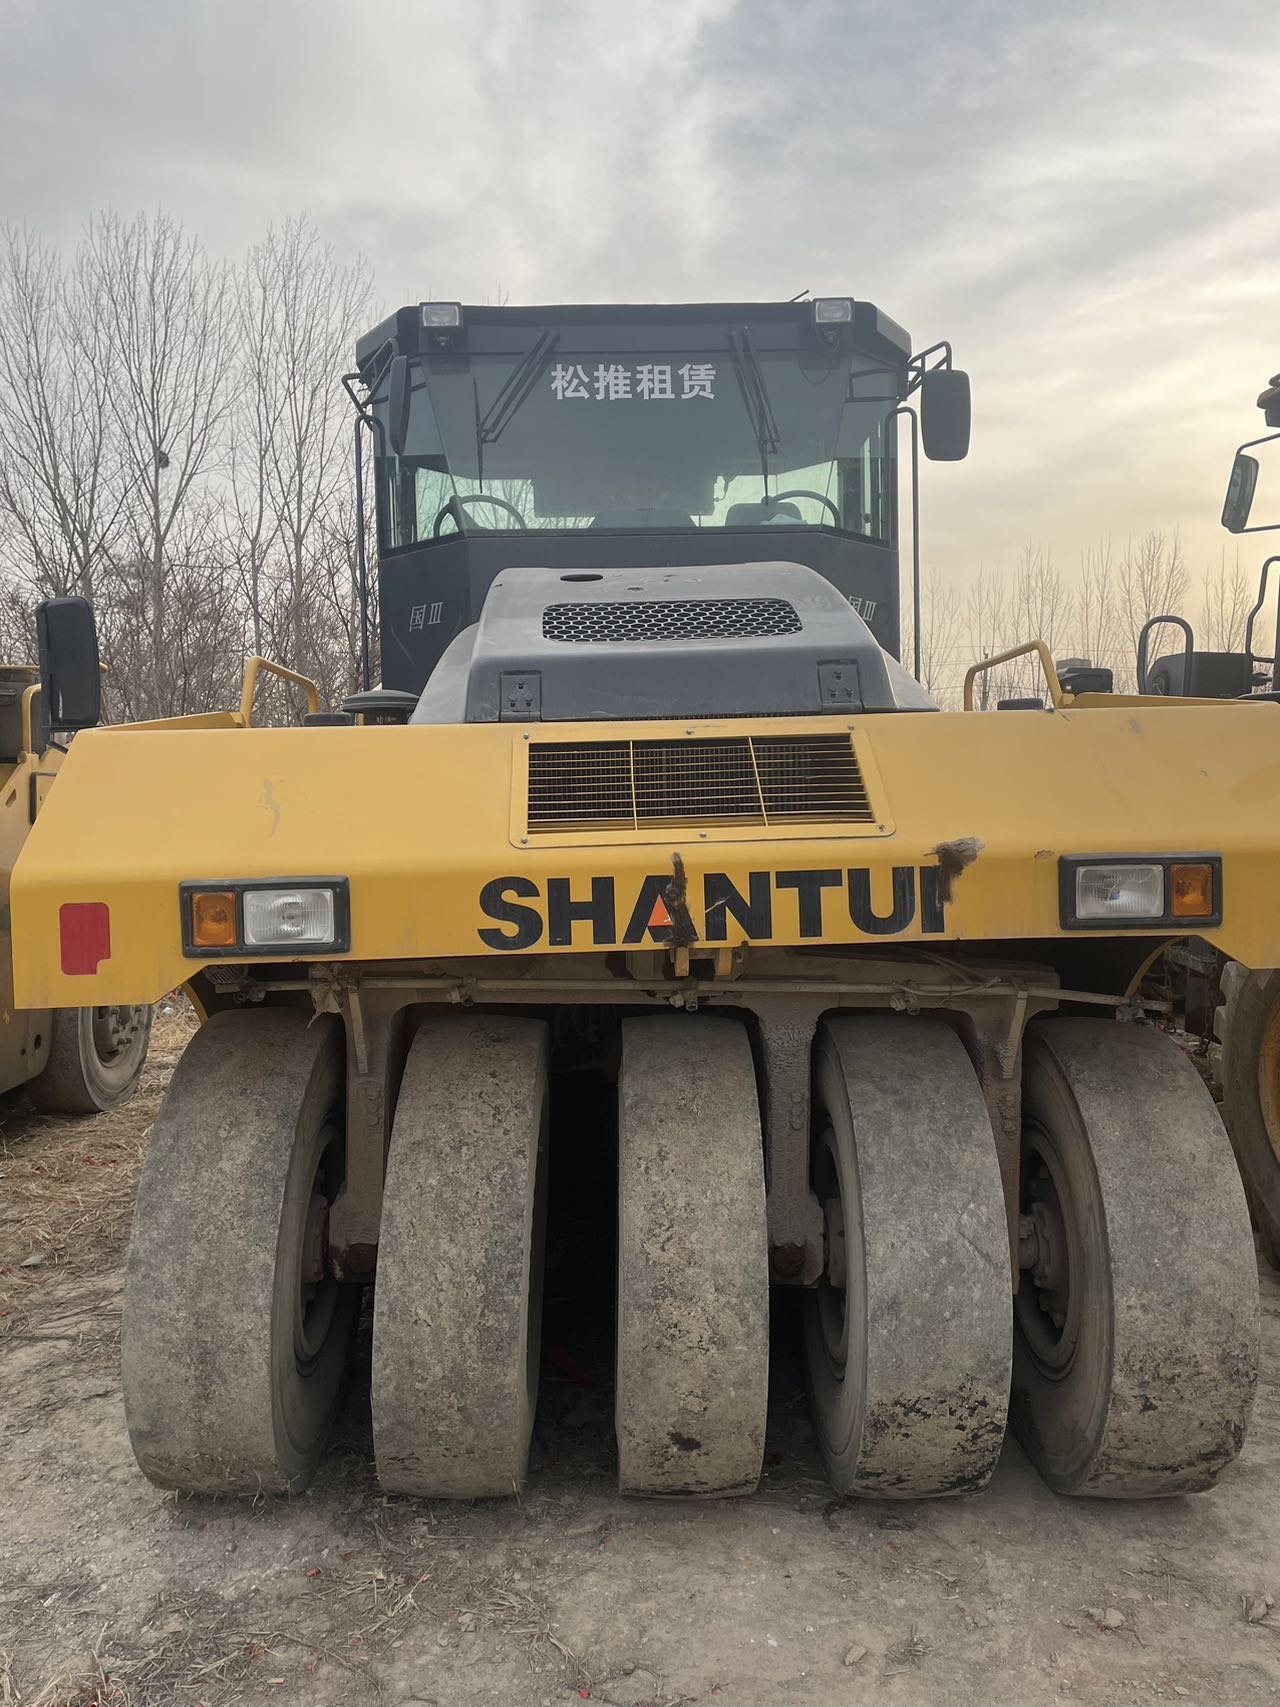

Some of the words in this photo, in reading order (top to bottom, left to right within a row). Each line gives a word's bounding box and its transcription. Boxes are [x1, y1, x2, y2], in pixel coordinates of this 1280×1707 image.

[550, 363, 716, 401] 松推租赁
[477, 865, 946, 951] SHANTUI
